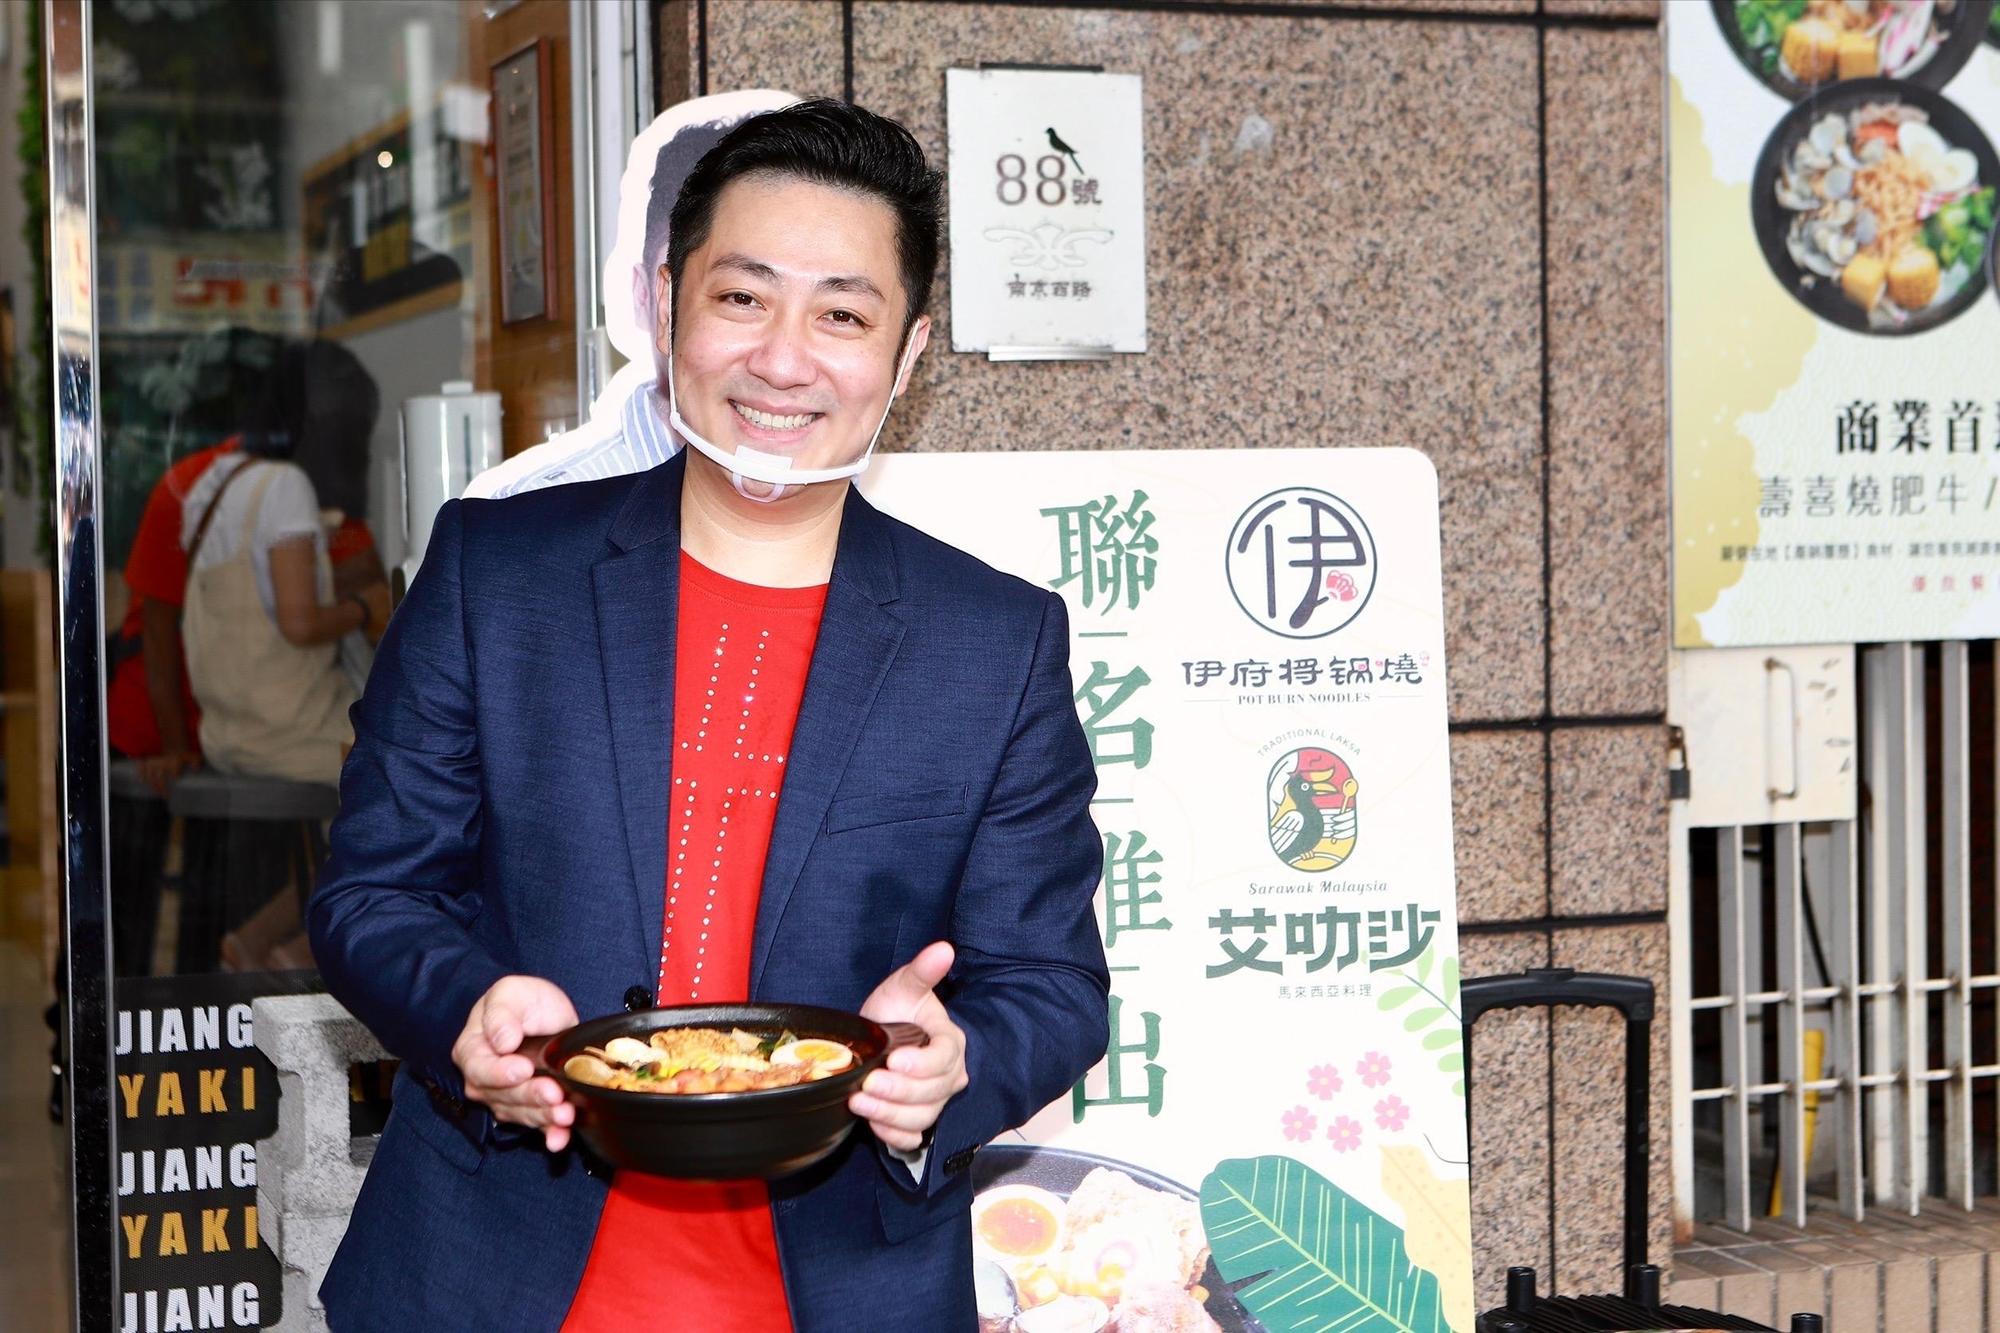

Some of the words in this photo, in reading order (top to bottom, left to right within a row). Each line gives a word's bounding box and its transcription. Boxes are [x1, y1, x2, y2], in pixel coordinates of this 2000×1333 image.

[1835, 400, 2000, 453] 商業首
[1238, 695, 1264, 705] POT
[1268, 694, 1305, 704] BURN
[1309, 692, 1371, 703] NOODLES
[1257, 728, 1326, 756] TRADITIONAL
[1330, 732, 1361, 756] LAKSA
[1249, 882, 1315, 896] Sarawak
[1319, 880, 1388, 895] Malaysia
[115, 1003, 254, 1055] JIANG
[118, 1066, 256, 1119] YAKI
[118, 1143, 258, 1196] JIANG
[121, 1205, 259, 1259] YAKI
[120, 1281, 260, 1333] JIANG
